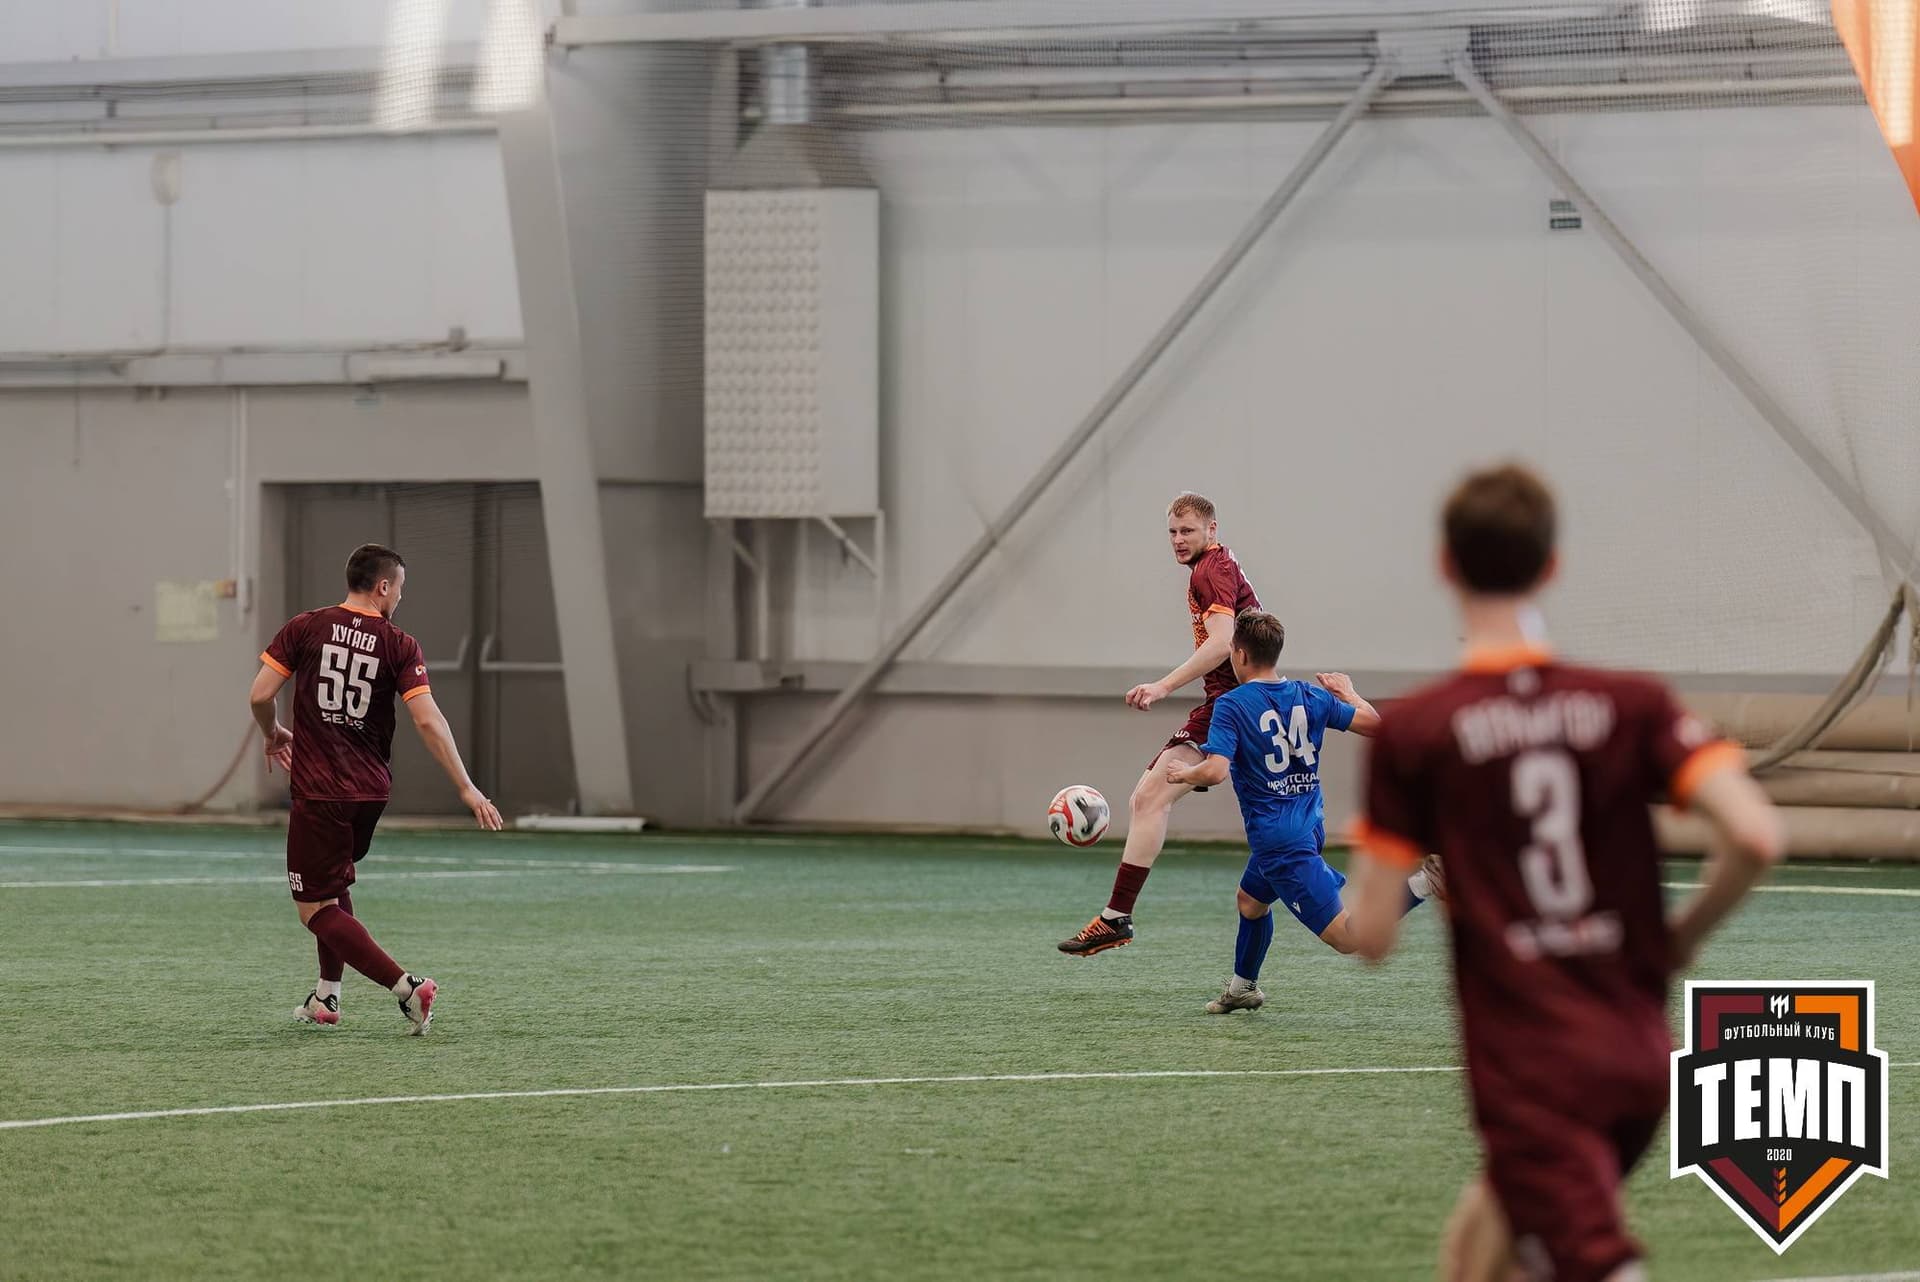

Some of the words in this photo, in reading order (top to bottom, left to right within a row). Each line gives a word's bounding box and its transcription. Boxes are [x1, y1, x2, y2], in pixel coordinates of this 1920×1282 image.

[331, 623, 377, 653] ХУГАЕВ
[317, 643, 380, 719] 55
[1259, 705, 1316, 774] 34
[1511, 750, 1596, 921] 3
[289, 871, 304, 892] 55
